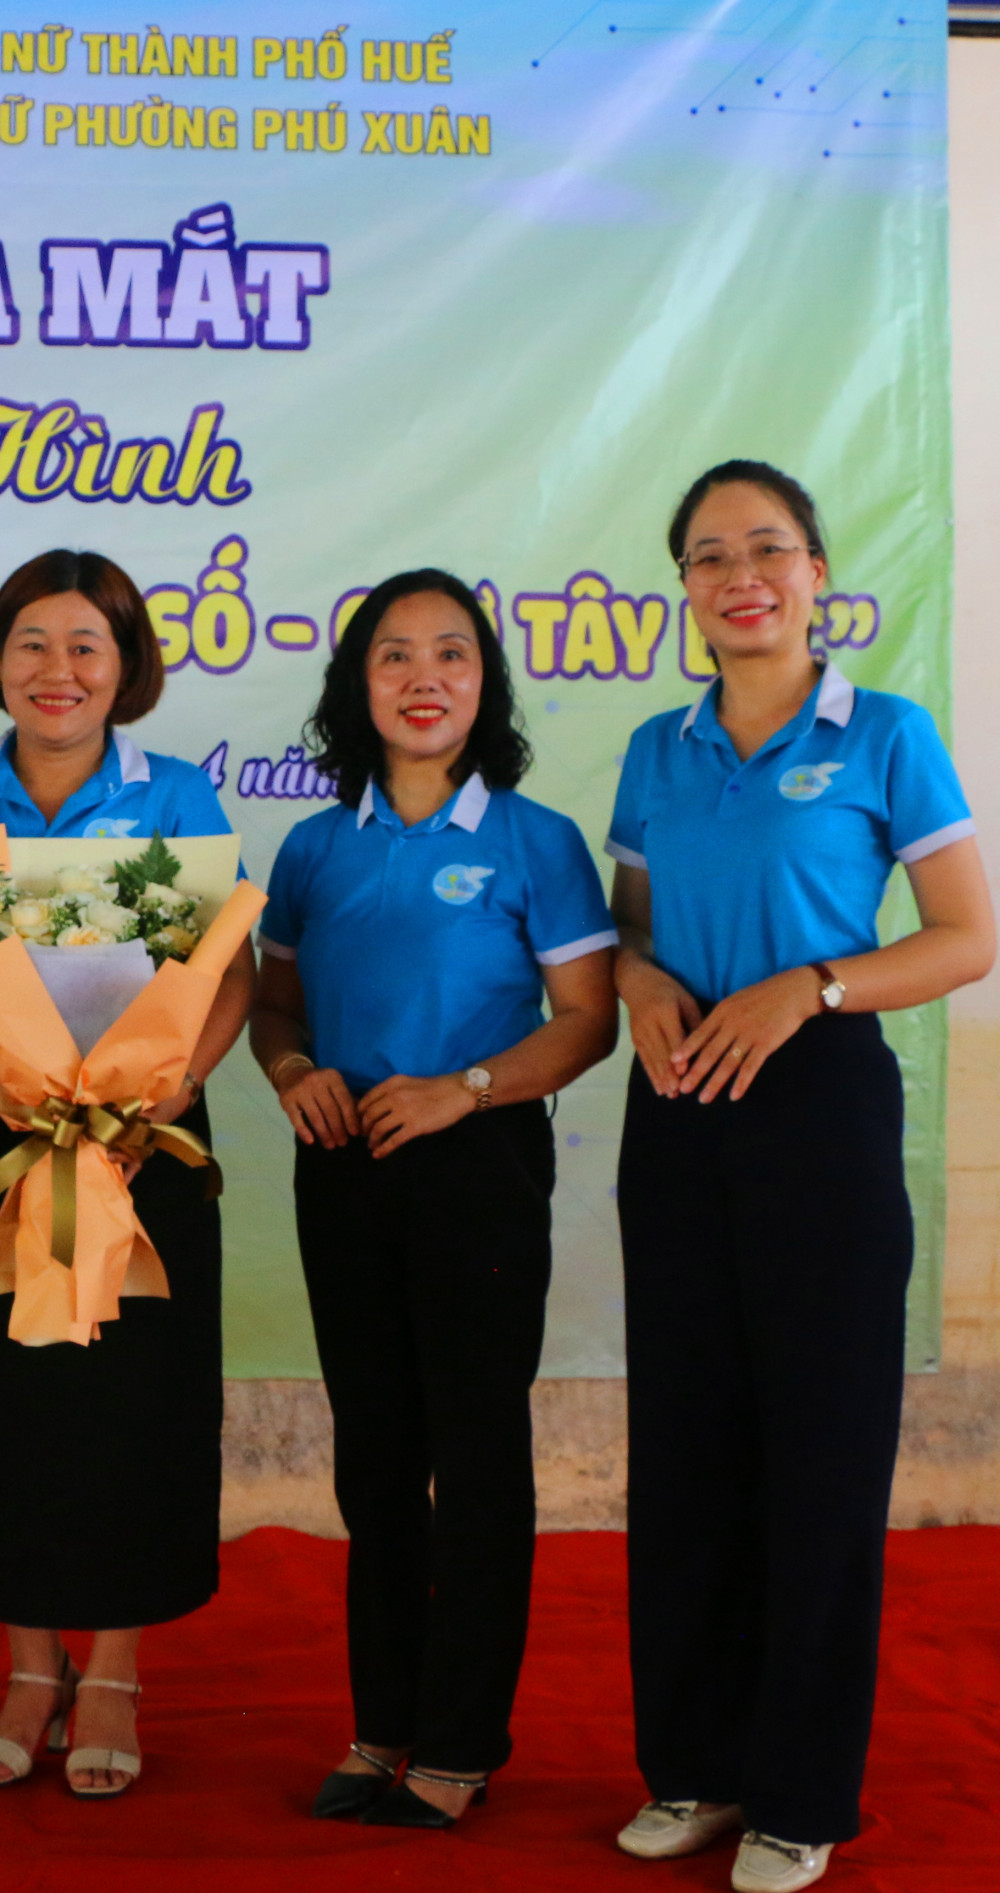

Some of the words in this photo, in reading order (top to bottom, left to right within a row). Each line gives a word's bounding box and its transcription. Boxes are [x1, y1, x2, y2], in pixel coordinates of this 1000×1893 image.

[1, 24, 73, 74] NỮ
[82, 25, 237, 77] THÀNH
[253, 24, 349, 80] PHỐ
[362, 29, 457, 83] HUẾ
[43, 95, 237, 149] PHƯỜNG
[253, 101, 347, 152] PHÚ
[361, 105, 492, 155] XUÂN
[40, 202, 330, 350] MẮT
[512, 570, 669, 681] TÂY
